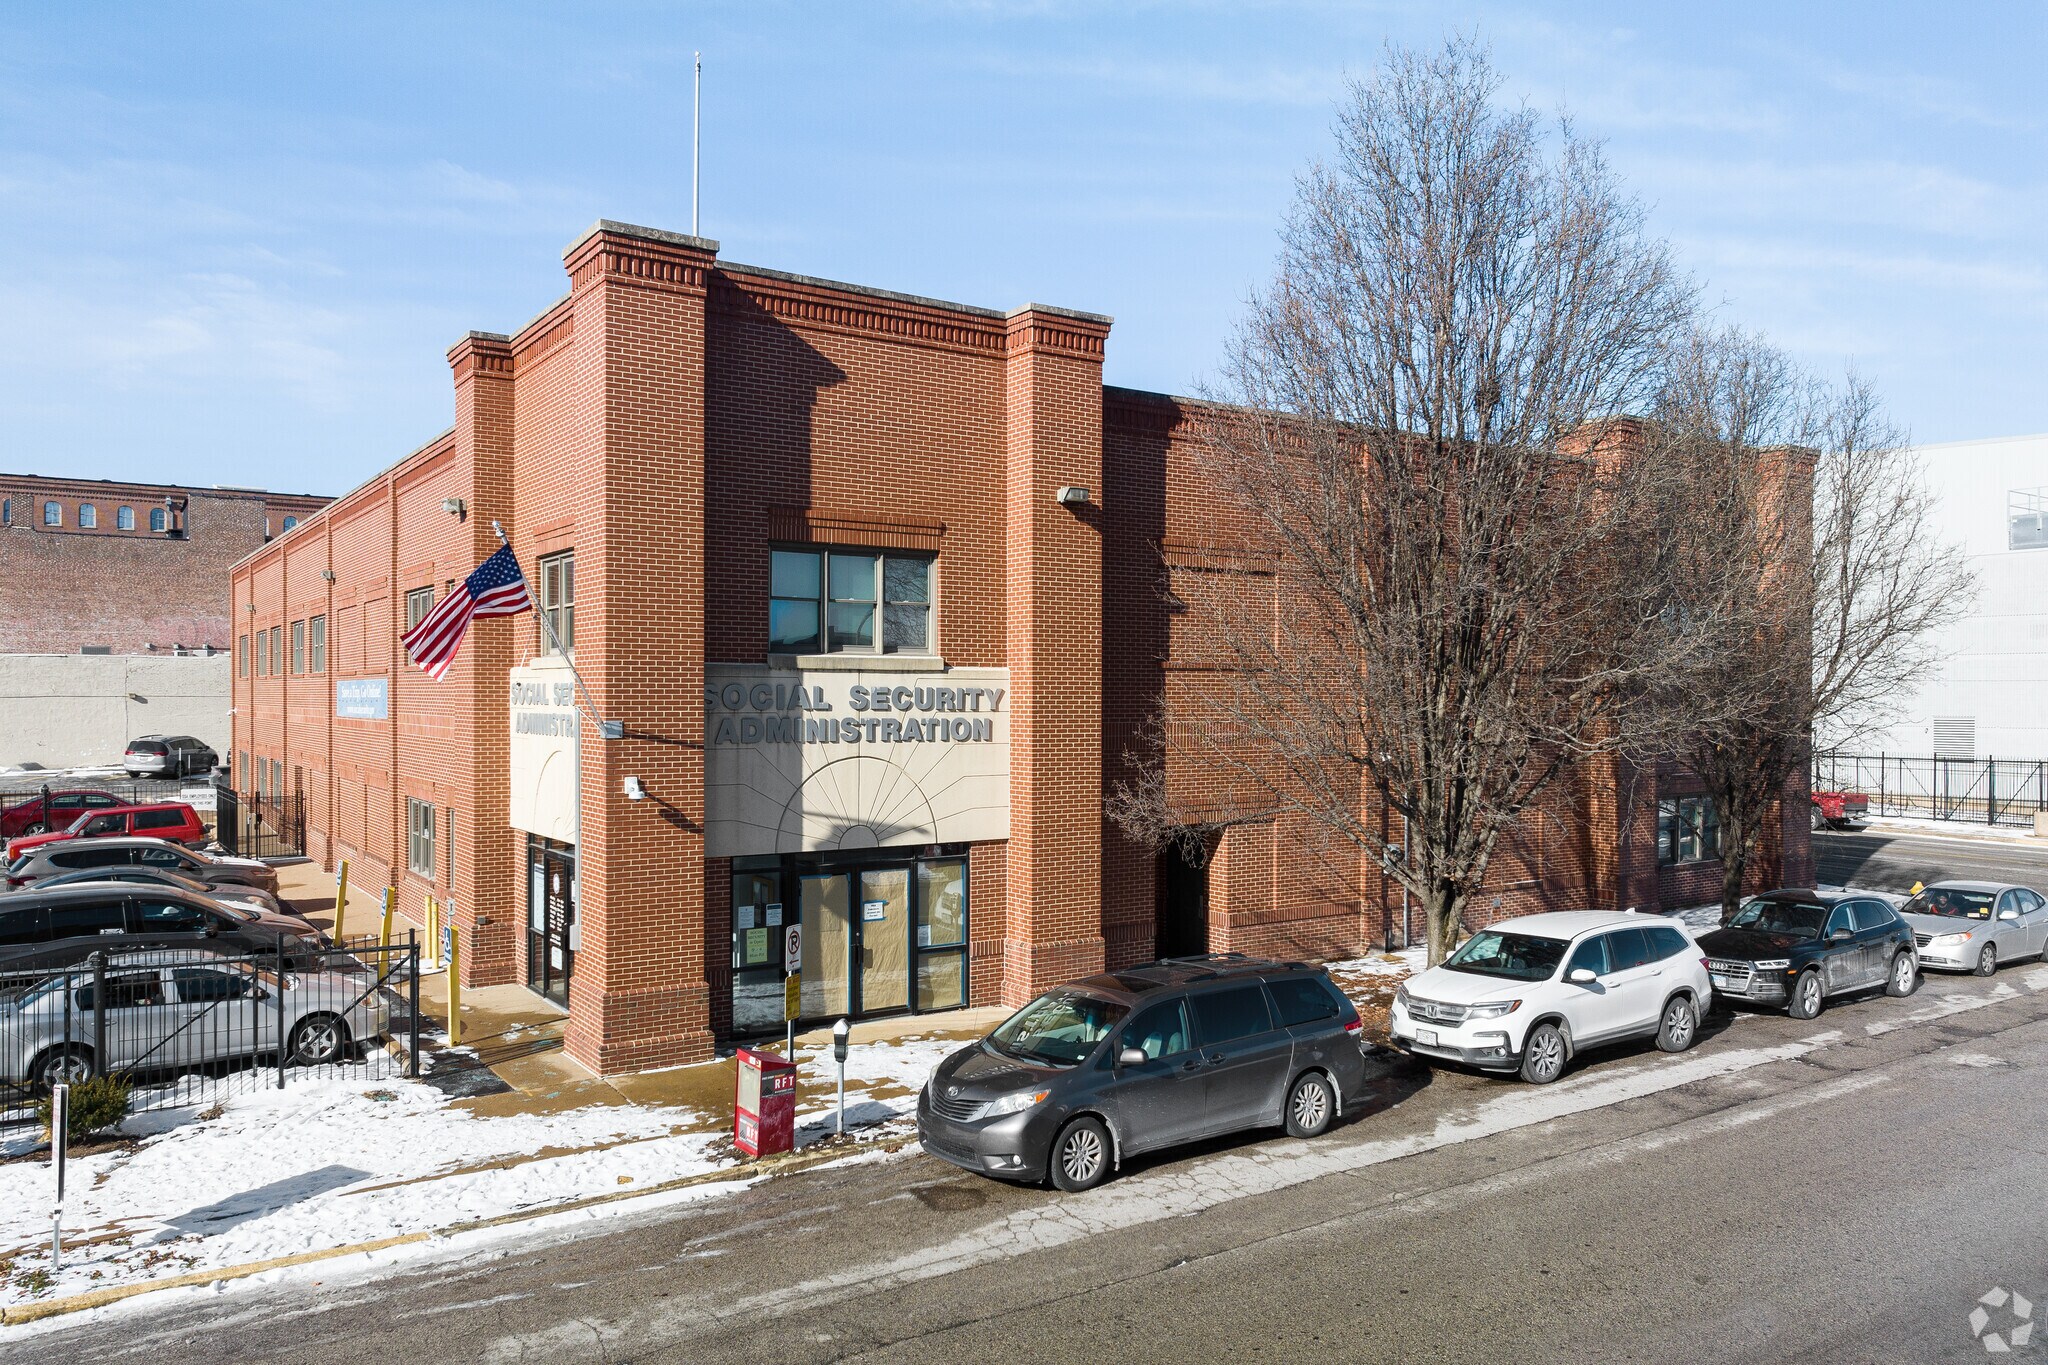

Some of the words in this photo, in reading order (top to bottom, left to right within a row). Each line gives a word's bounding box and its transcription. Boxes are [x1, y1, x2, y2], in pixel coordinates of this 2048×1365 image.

[511, 682, 549, 706] SOCIAL
[704, 682, 832, 711] SOCIAL
[849, 684, 1006, 712] SECURITY
[714, 717, 993, 744] ADMINISTRATION
[774, 1075, 795, 1090] RFT
